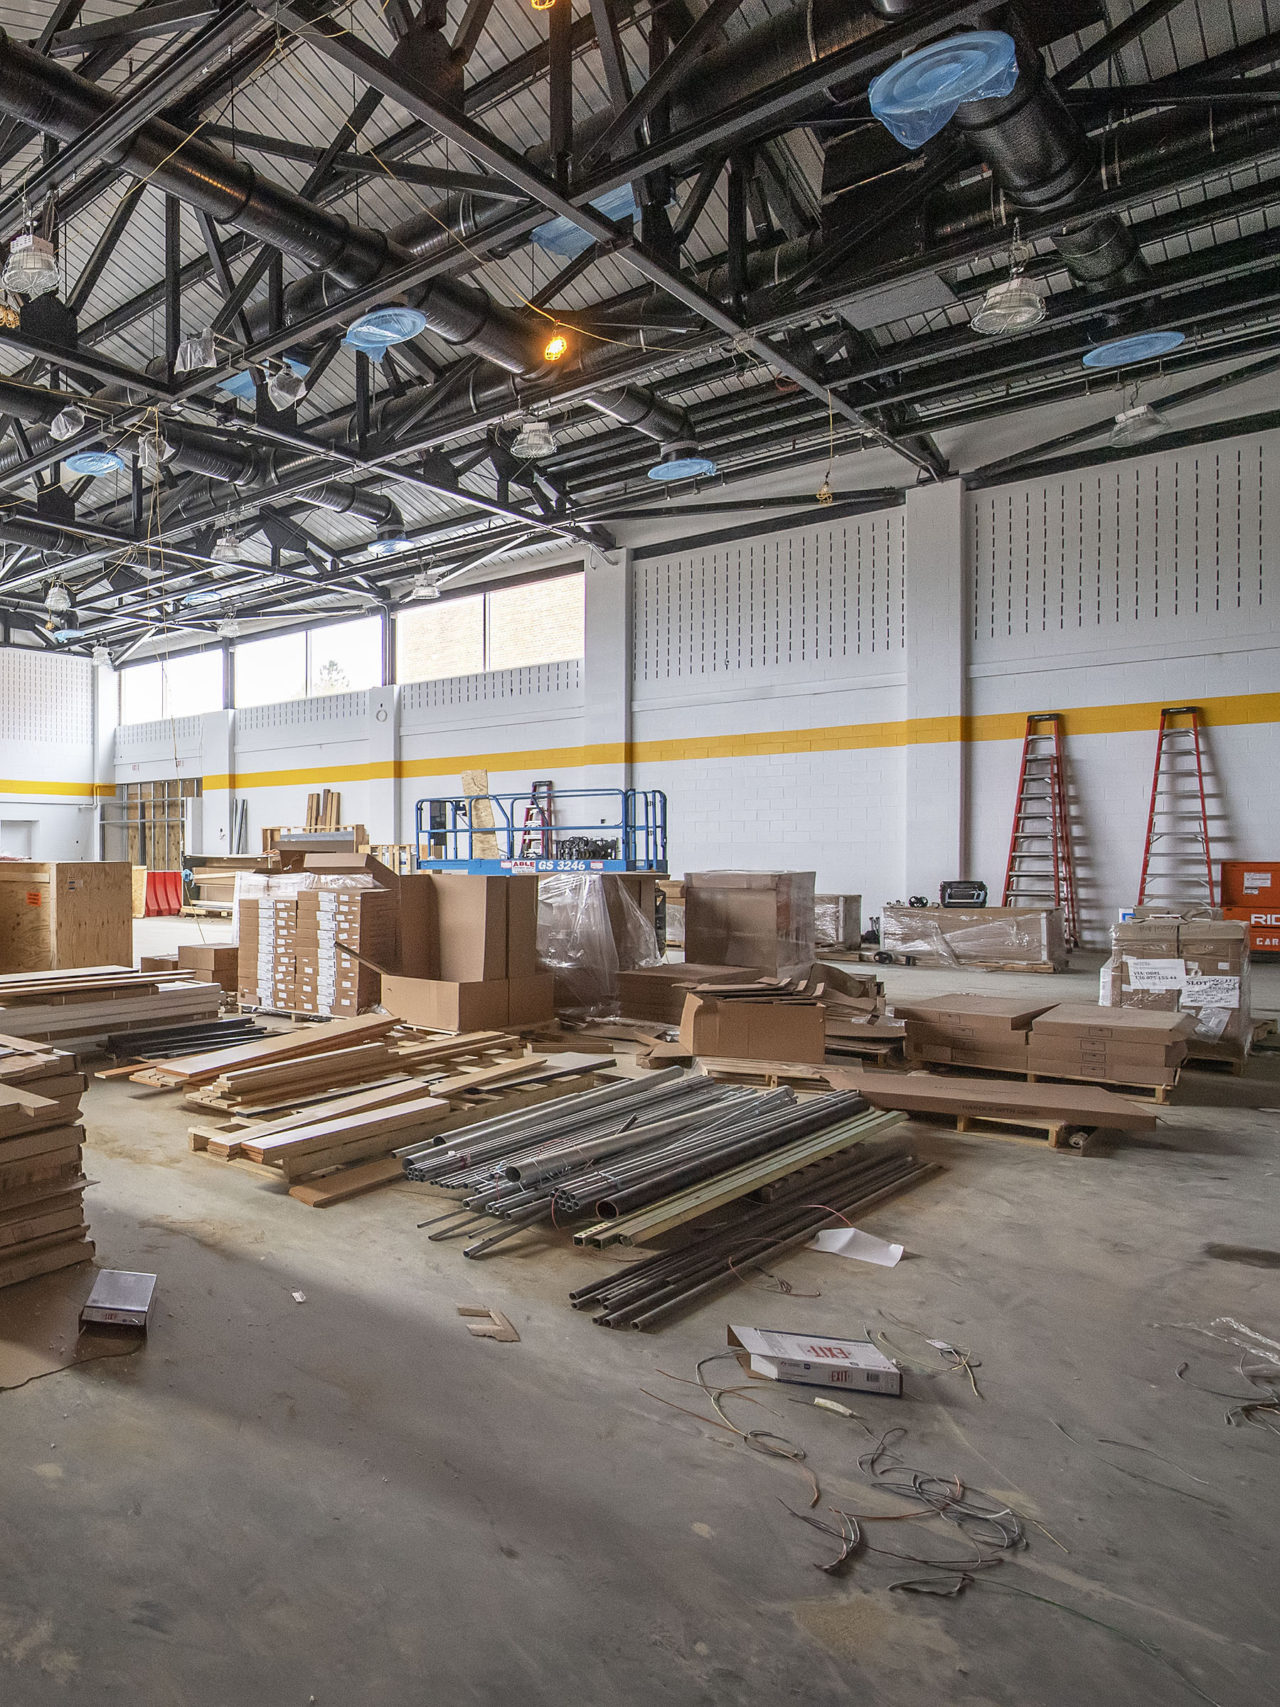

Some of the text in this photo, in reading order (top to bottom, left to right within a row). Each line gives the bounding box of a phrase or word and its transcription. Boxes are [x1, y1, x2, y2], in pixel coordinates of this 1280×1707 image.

[538, 861, 554, 870] GS
[557, 861, 586, 870] 3246
[809, 1345, 849, 1358] EXIT
[831, 1370, 849, 1382] EXIT
